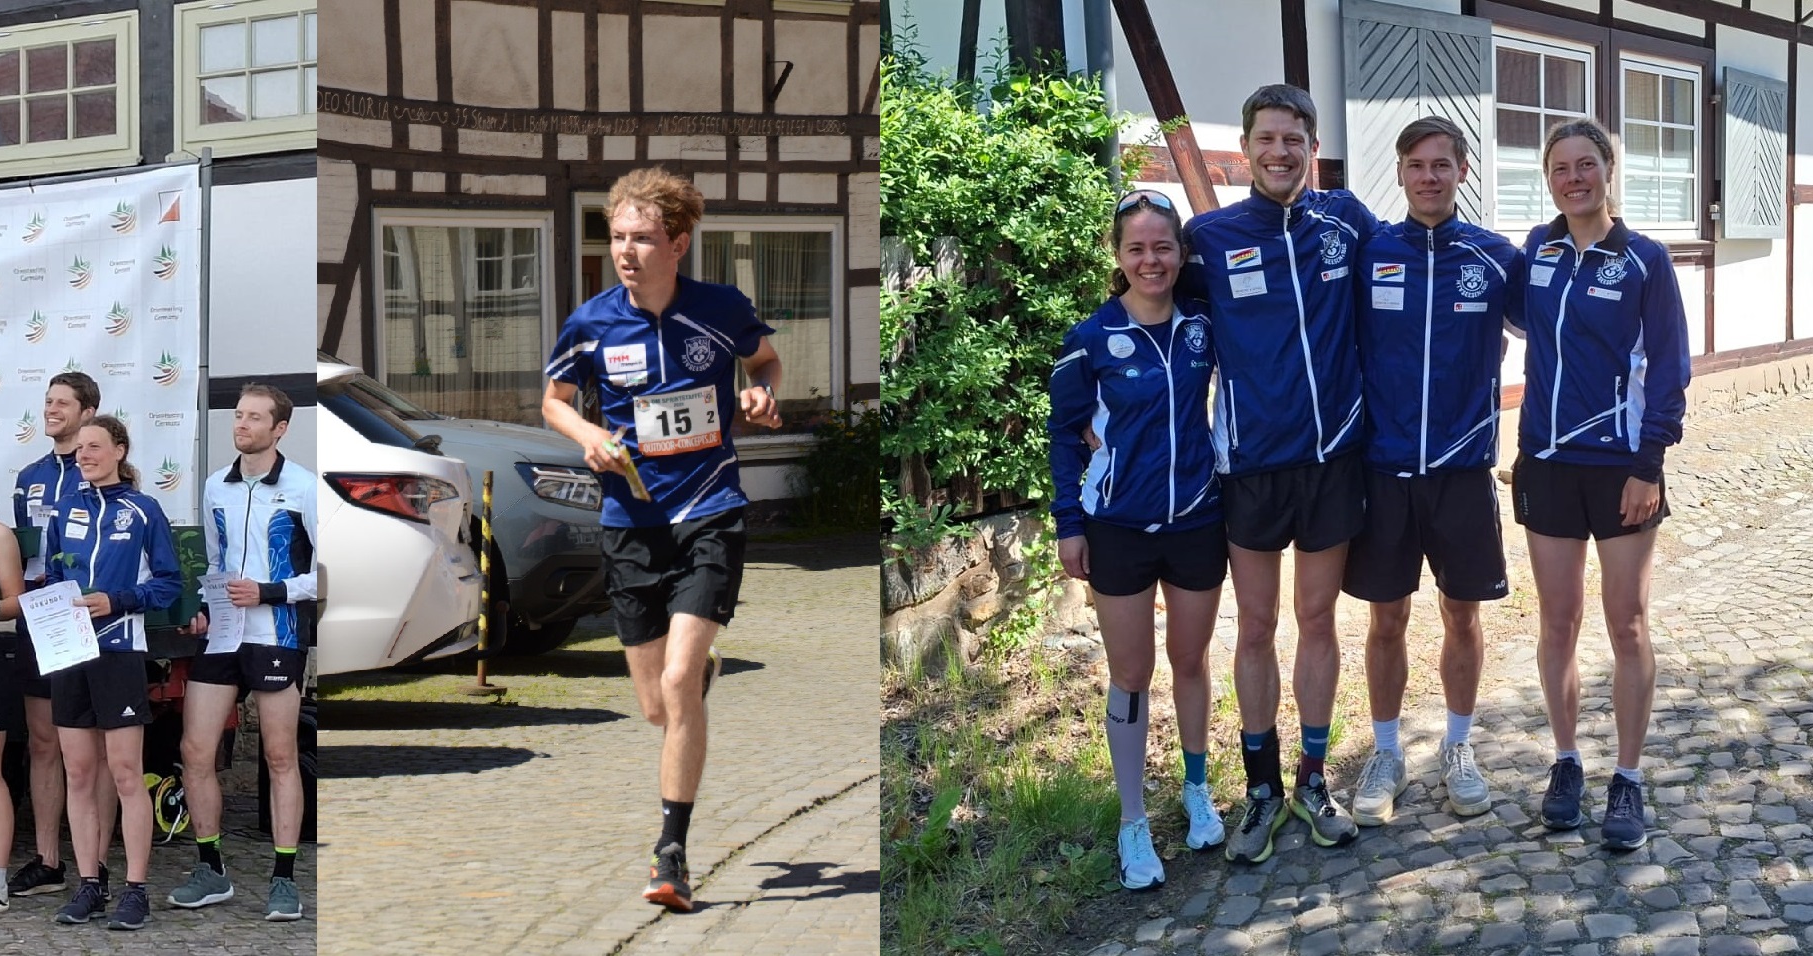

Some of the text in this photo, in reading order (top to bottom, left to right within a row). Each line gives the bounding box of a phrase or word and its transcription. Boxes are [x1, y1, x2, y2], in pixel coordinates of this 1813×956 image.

[343, 93, 389, 120] GLORIA
[608, 355, 629, 364] TMM
[656, 408, 715, 437] 15 2
[643, 432, 717, 452] OUTDOOR-CONCEPTS.DE
